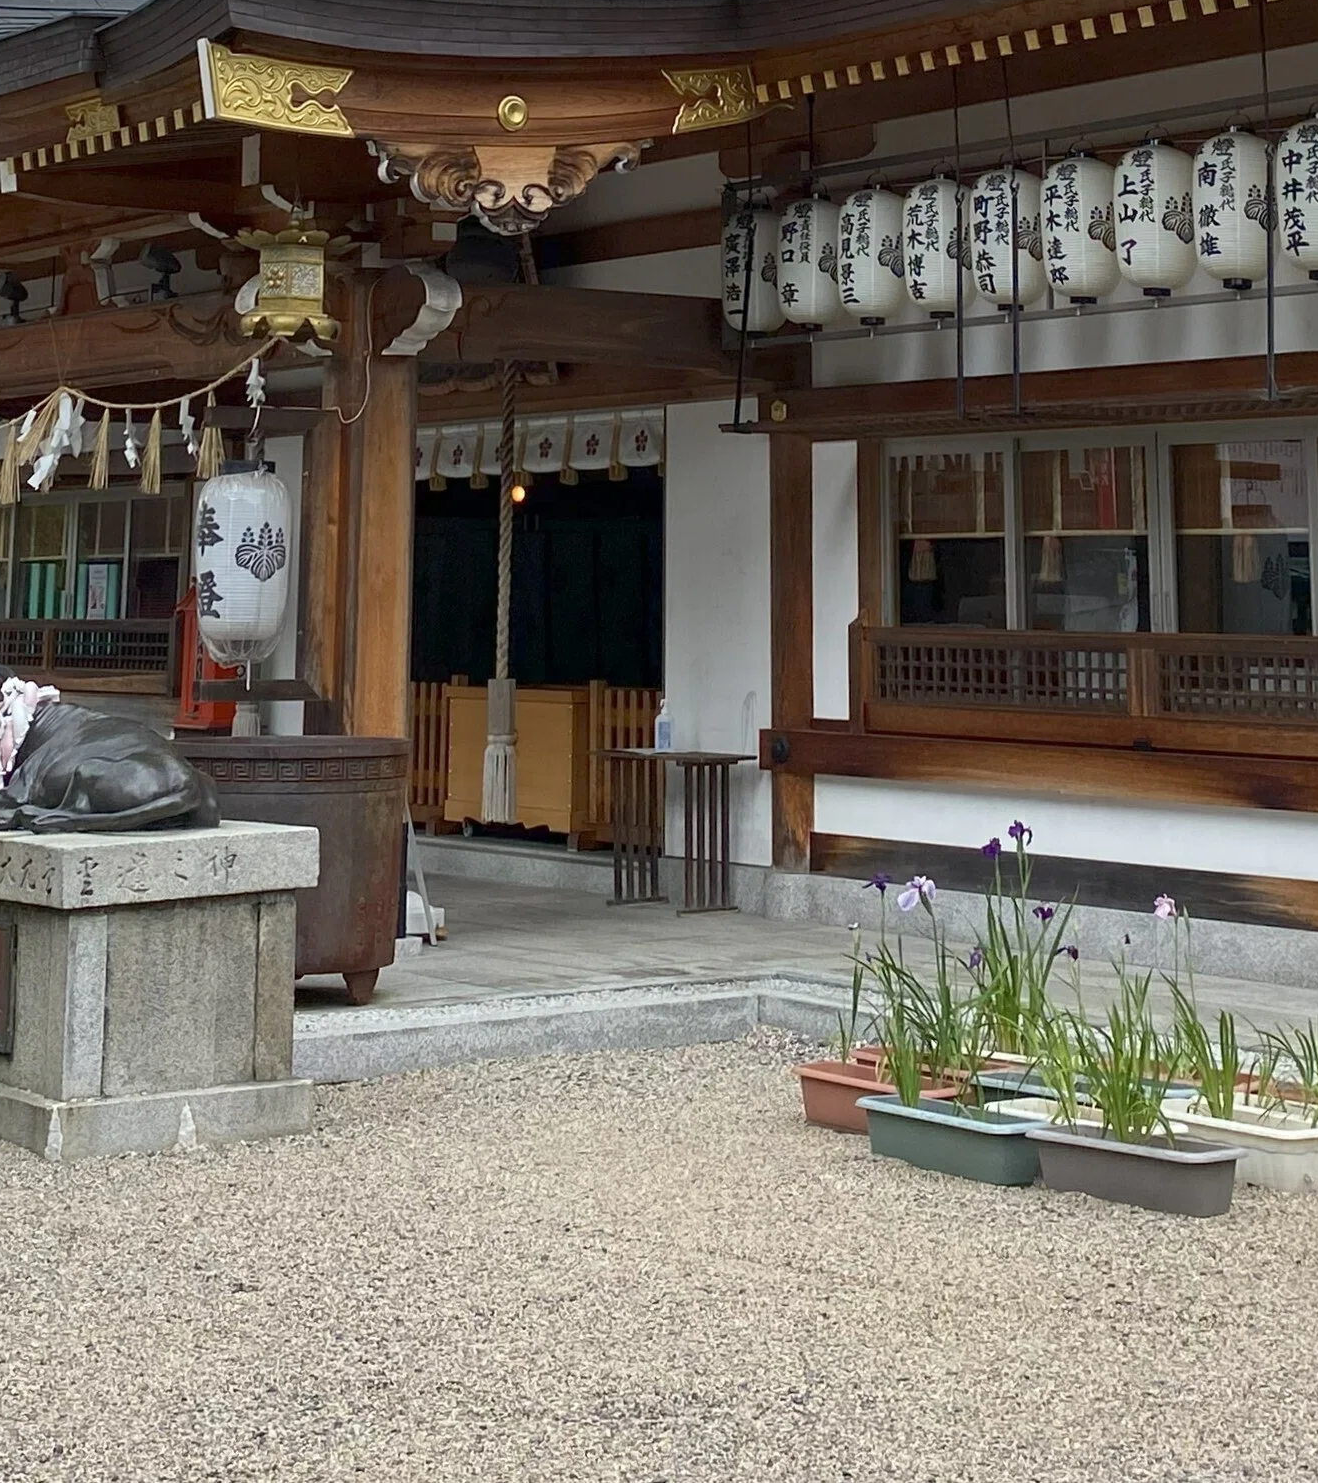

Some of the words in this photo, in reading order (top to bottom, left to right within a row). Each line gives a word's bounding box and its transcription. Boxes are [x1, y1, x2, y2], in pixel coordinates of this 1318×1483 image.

[906, 204, 928, 301] 荒木博吉
[973, 194, 997, 295] 町野恭司
[1044, 184, 1070, 286] 平木達郎
[1282, 148, 1310, 257] 中井茂平
[838, 212, 860, 305] 高見景三
